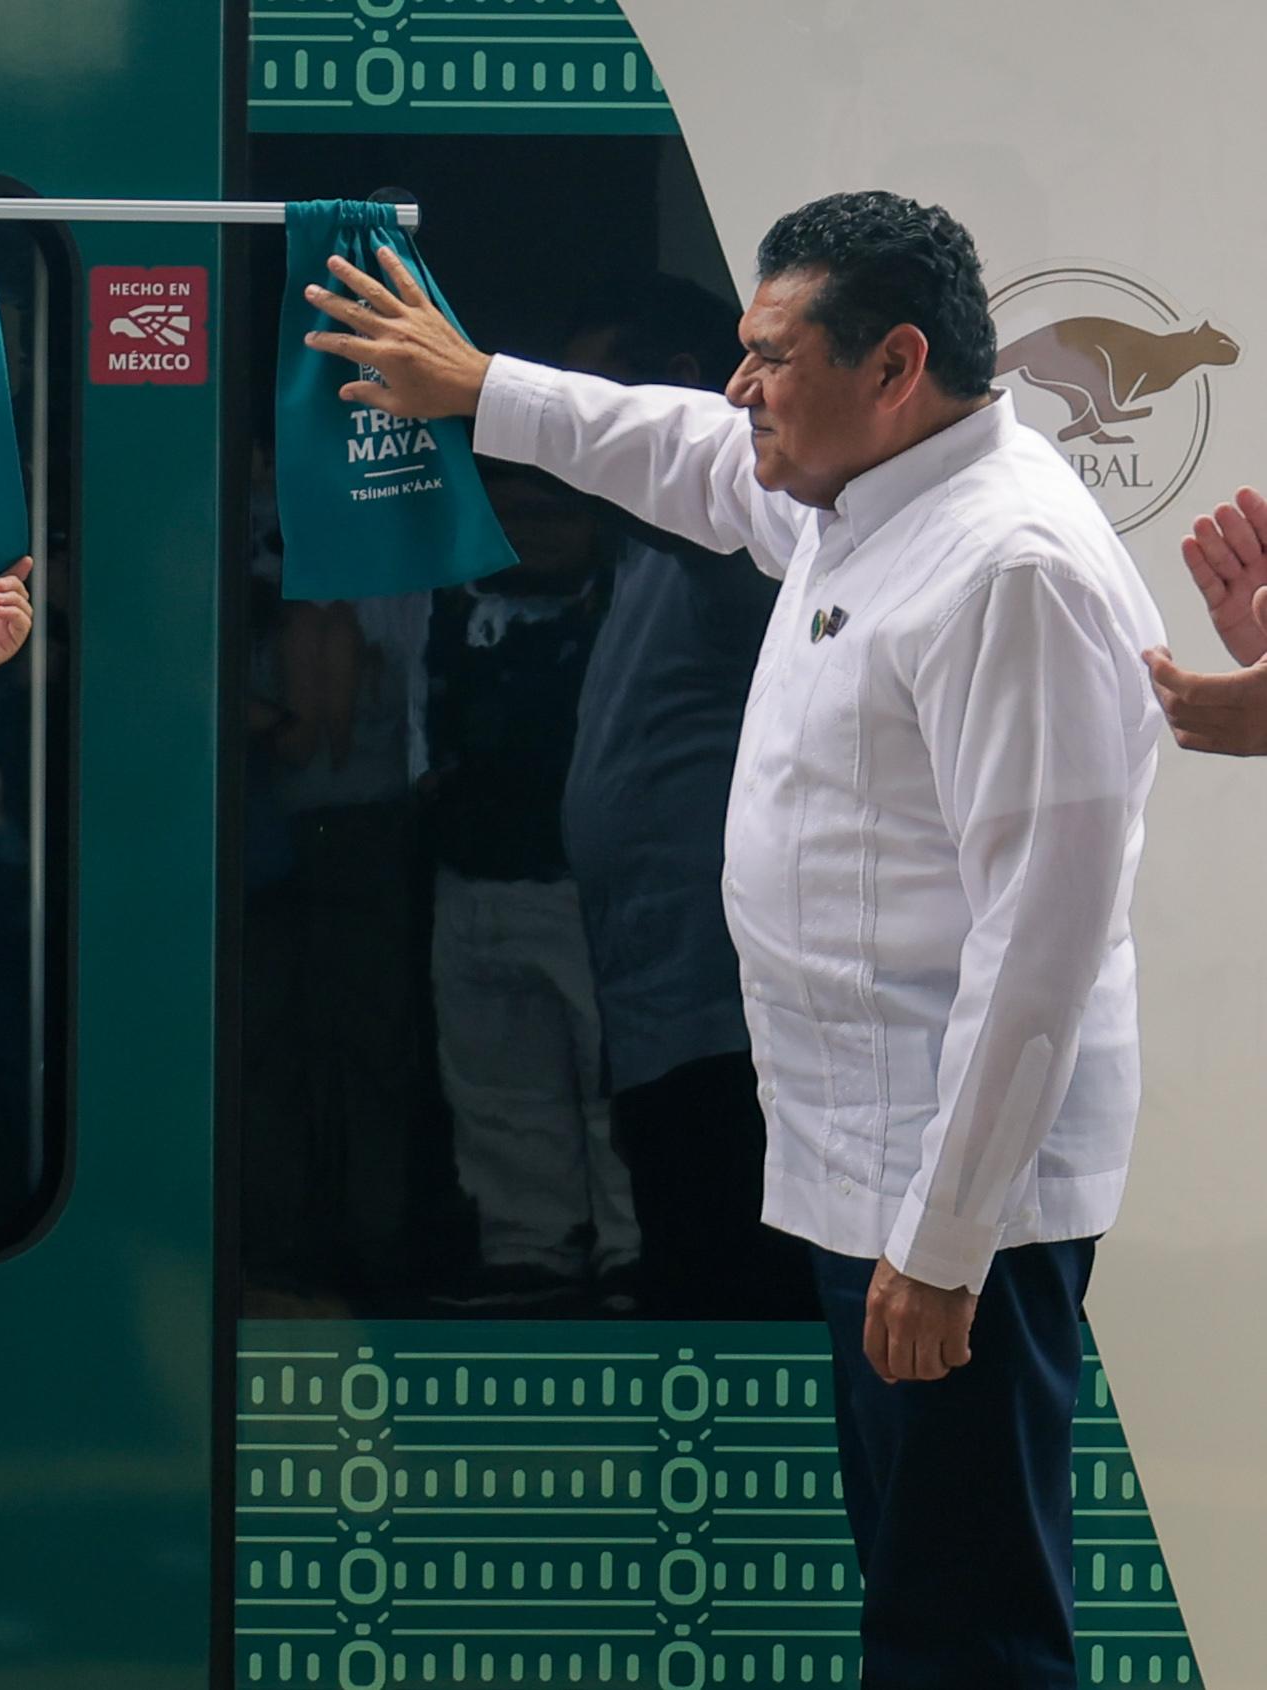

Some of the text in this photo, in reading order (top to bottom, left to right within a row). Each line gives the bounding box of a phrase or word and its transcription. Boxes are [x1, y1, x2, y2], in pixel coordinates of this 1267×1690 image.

[109, 283, 190, 296] HECHO EN
[108, 350, 190, 371] MÉXICO
[350, 408, 429, 435] TRE
[347, 428, 437, 463] MAYA
[1069, 453, 1154, 488] BAL
